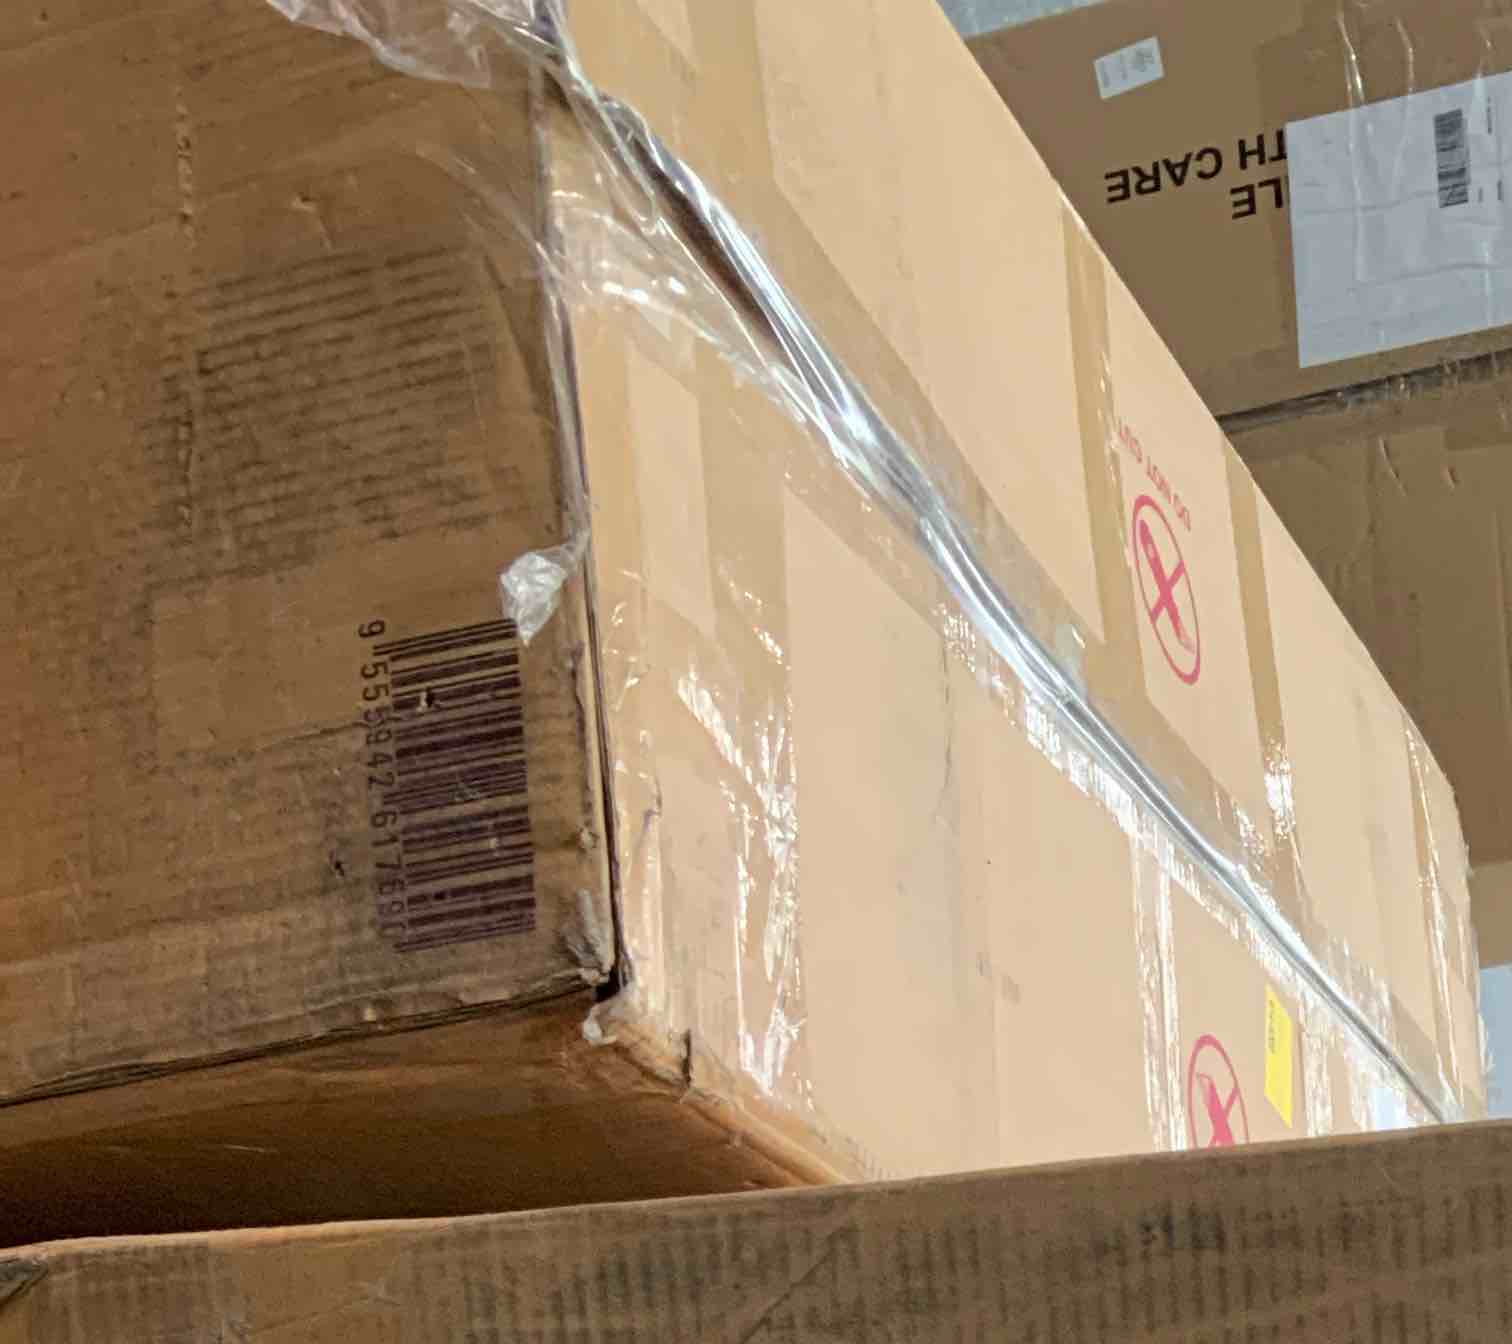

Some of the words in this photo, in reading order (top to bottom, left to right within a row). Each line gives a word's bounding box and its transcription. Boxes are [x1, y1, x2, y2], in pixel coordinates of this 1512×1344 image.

[1238, 128, 1288, 170] TH
[1104, 147, 1223, 204] CARE
[1230, 176, 1286, 219] LE
[358, 619, 386, 640] 9
